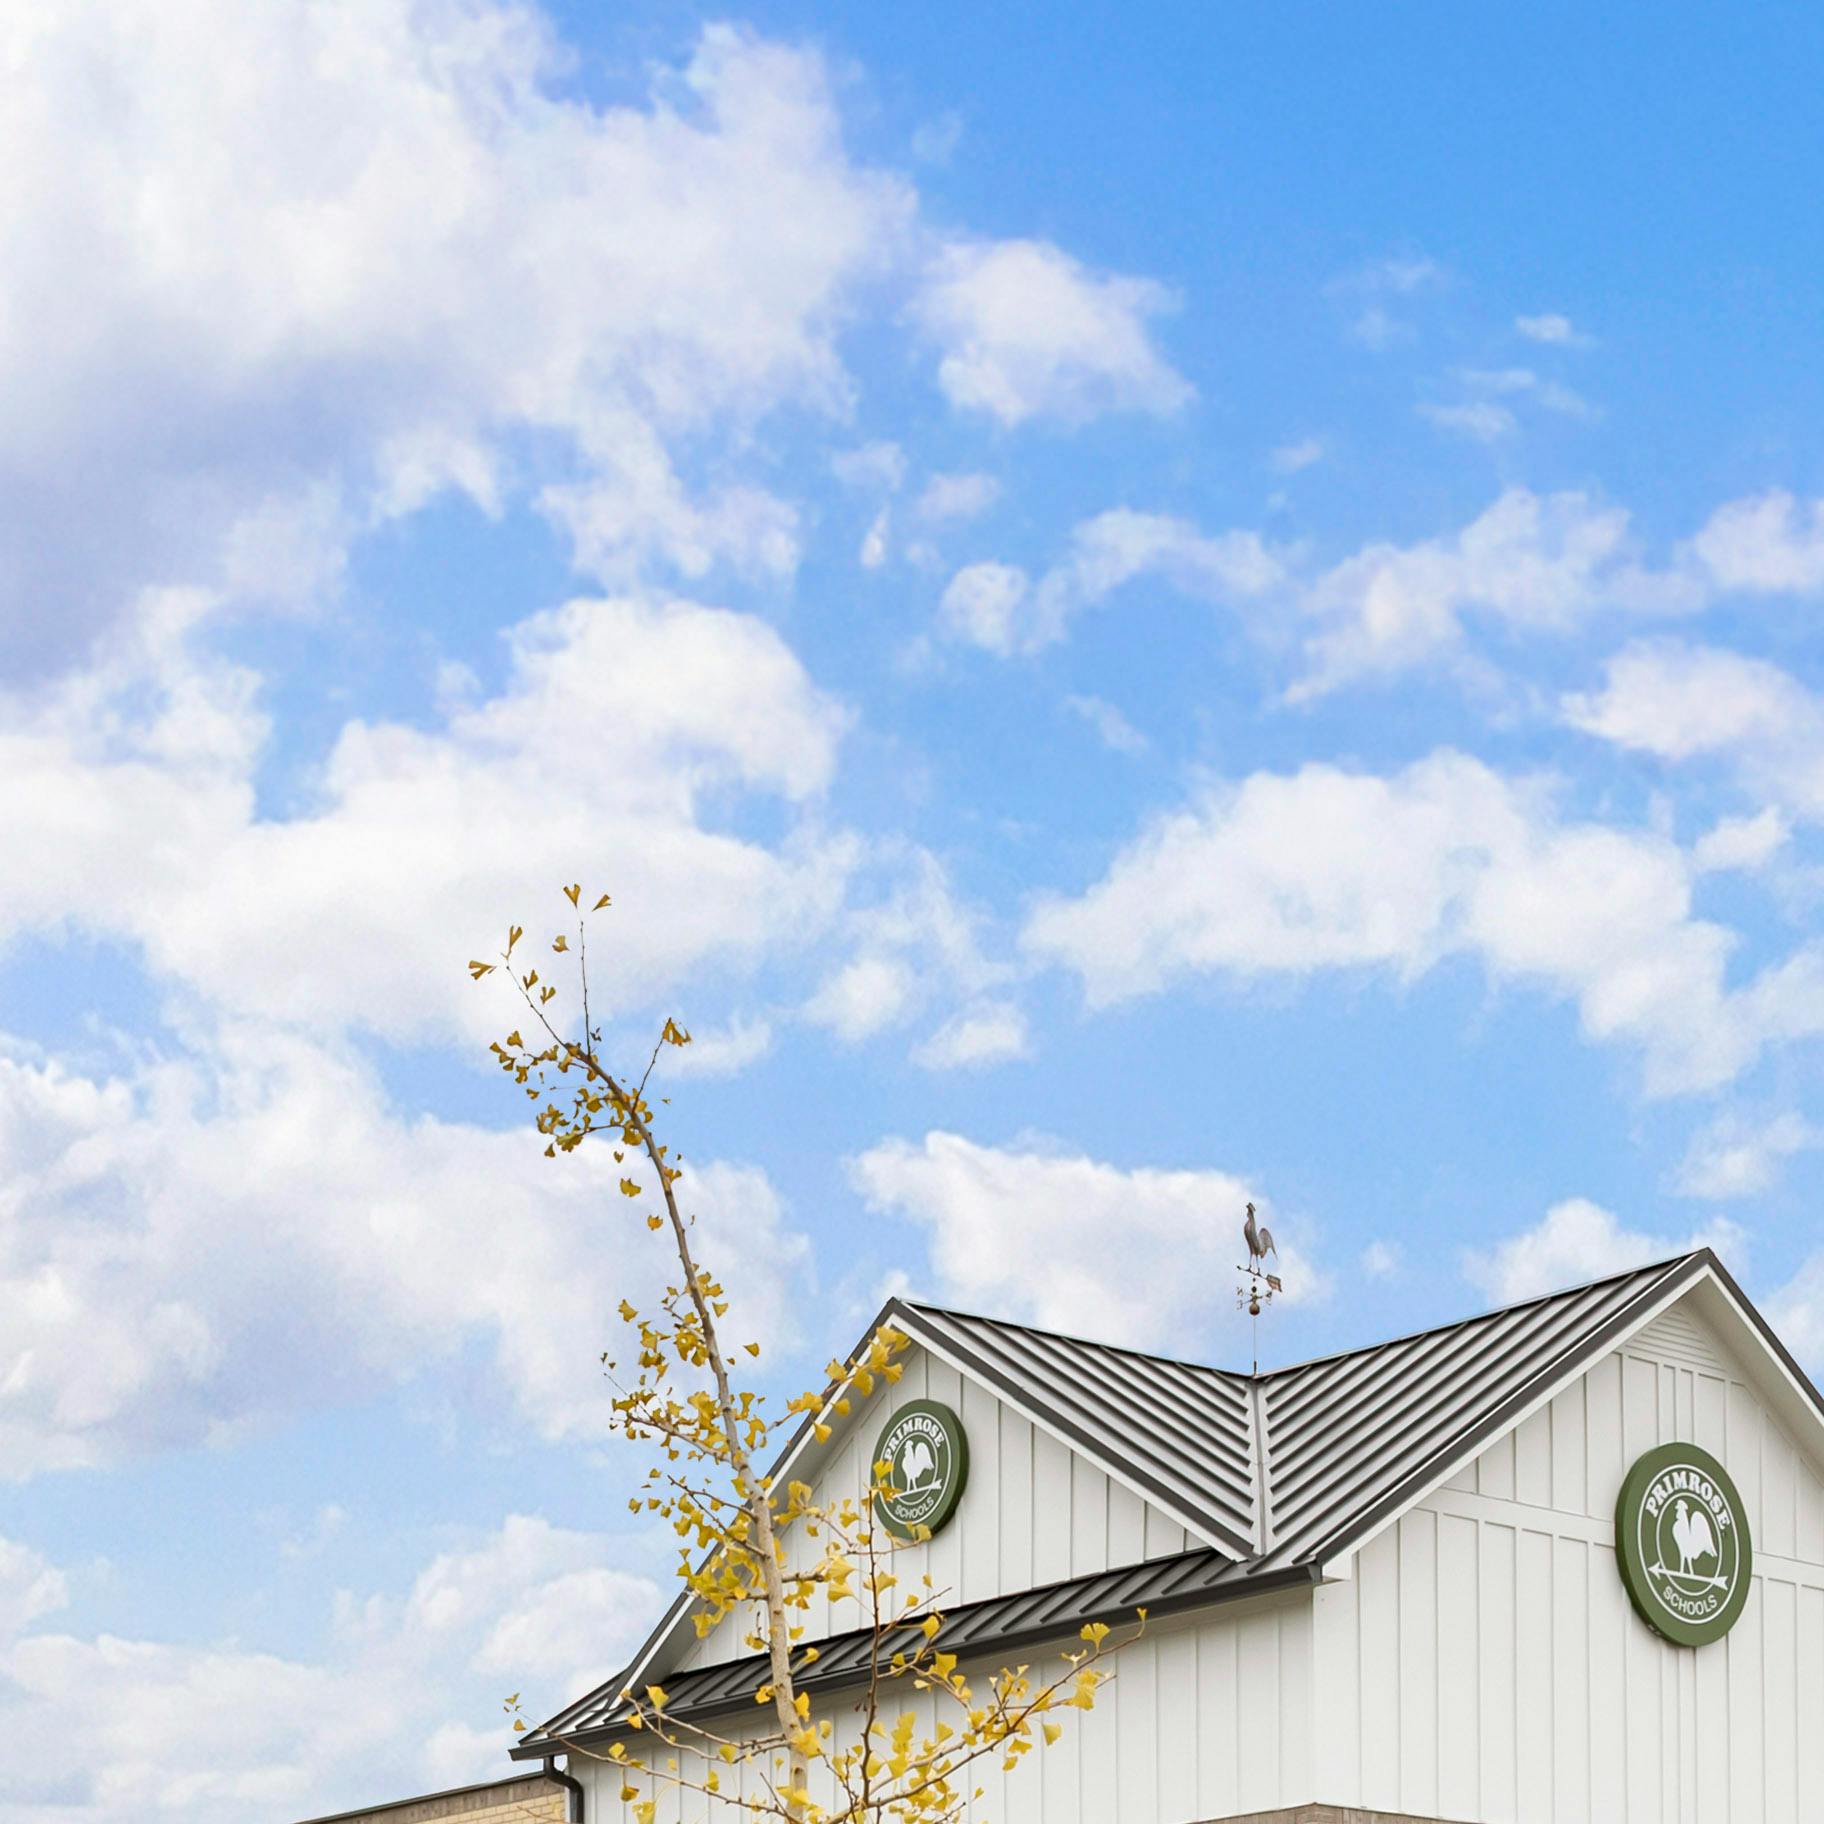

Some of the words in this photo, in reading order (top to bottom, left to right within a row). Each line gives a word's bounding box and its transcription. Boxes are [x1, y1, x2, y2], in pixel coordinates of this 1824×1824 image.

[883, 1417, 945, 1462] PRIMROSE
[894, 1496, 934, 1519] SCHOOLS
[1645, 1471, 1731, 1530] PRIMROSE
[1662, 1586, 1718, 1616] SCHOOLS
